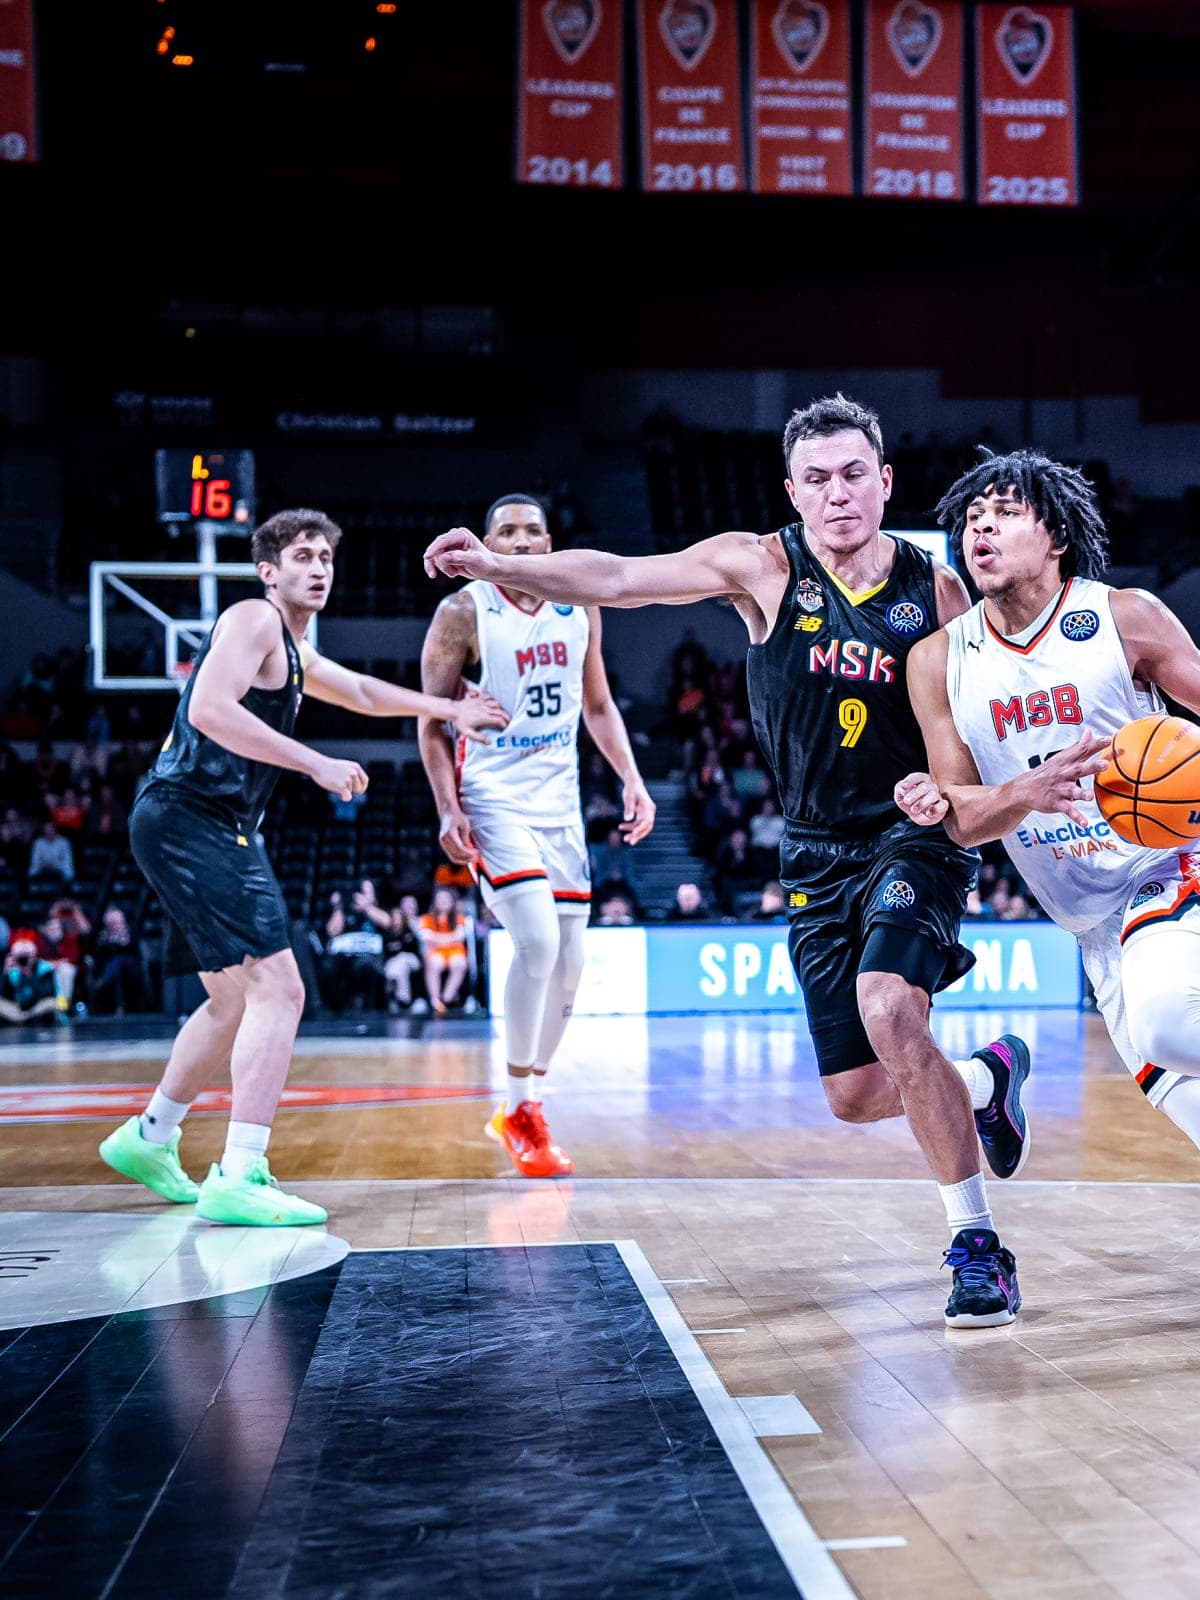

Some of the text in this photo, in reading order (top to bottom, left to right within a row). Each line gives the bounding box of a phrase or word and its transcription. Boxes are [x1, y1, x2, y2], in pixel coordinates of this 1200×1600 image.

[658, 87, 724, 103] COUPE
[983, 98, 1068, 118] LEADERS
[655, 128, 731, 144] FRANCE
[876, 133, 949, 152] FRANCE
[1005, 122, 1046, 140] CUP
[528, 155, 613, 185] 2014
[655, 163, 737, 191] 2016
[874, 167, 955, 197] 2018
[987, 176, 1069, 203] 2025
[191, 480, 233, 519] 16
[516, 641, 568, 676] MSB
[809, 640, 896, 682] MSK
[526, 682, 561, 718] 35
[989, 683, 1084, 741] MSB
[838, 698, 868, 748] 9
[700, 942, 797, 997] SPA
